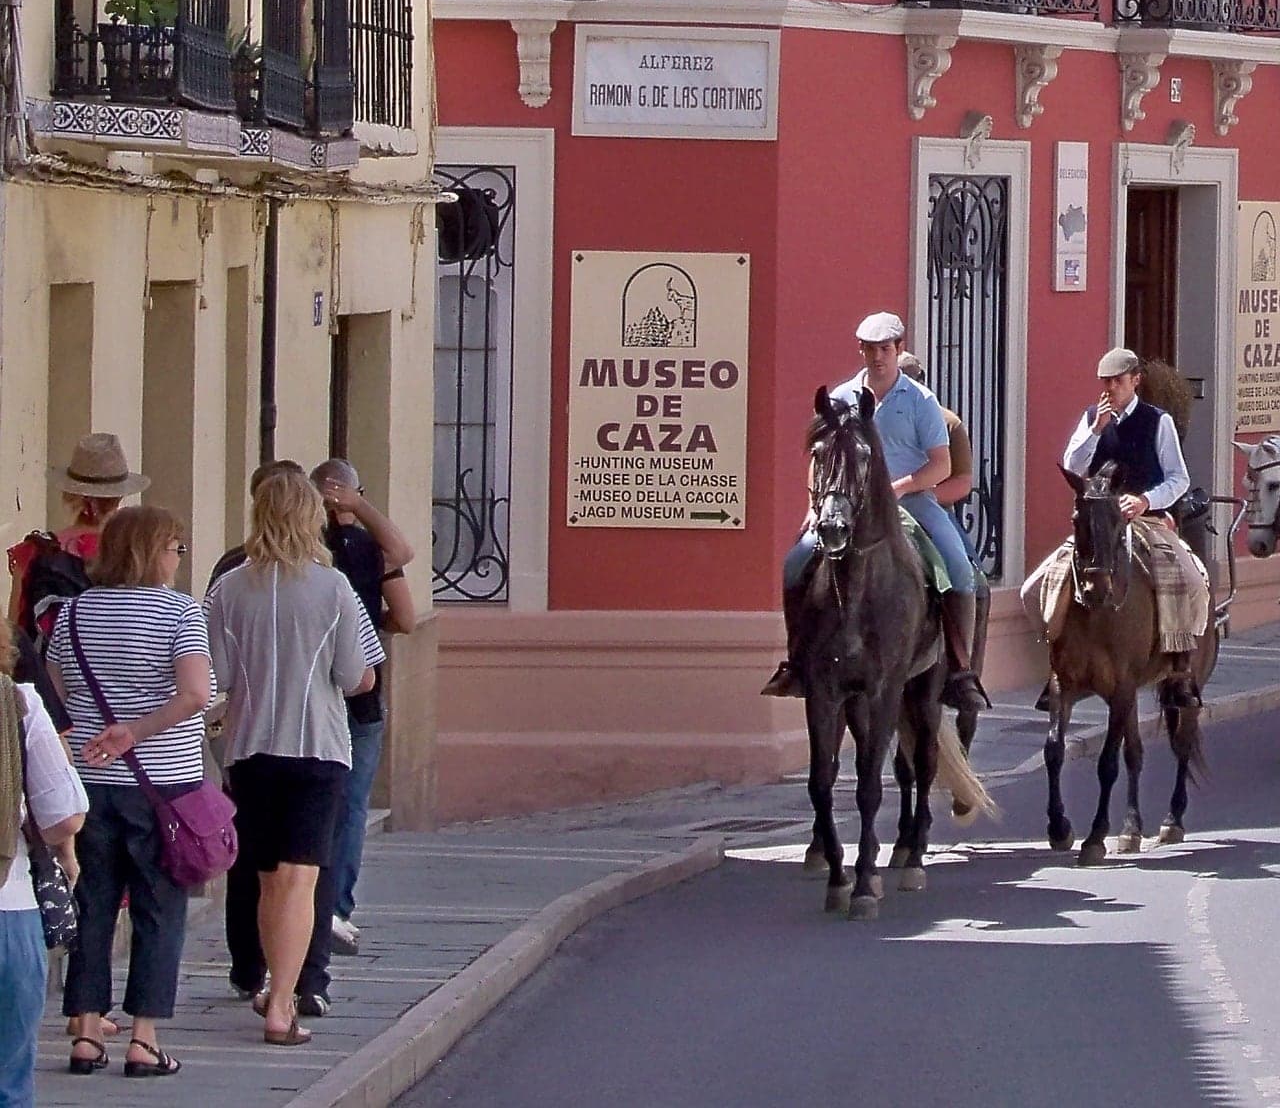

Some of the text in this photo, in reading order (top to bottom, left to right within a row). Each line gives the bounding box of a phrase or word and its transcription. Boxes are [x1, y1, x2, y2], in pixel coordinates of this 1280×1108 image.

[639, 55, 714, 71] ALFEREZ
[590, 84, 762, 111] RAMON G. DE LAS CORTINAS
[1255, 320, 1270, 337] DE
[580, 358, 739, 389] MUSEO
[636, 394, 682, 418] DE
[597, 422, 717, 453] CAZA
[574, 457, 713, 470] -HUNTING MUSEUM
[574, 473, 737, 487] -MUSEE DE LA CHASSE
[574, 490, 738, 504] -MUSEO DELLA CACCIA
[621, 507, 684, 519] MUSEUM
